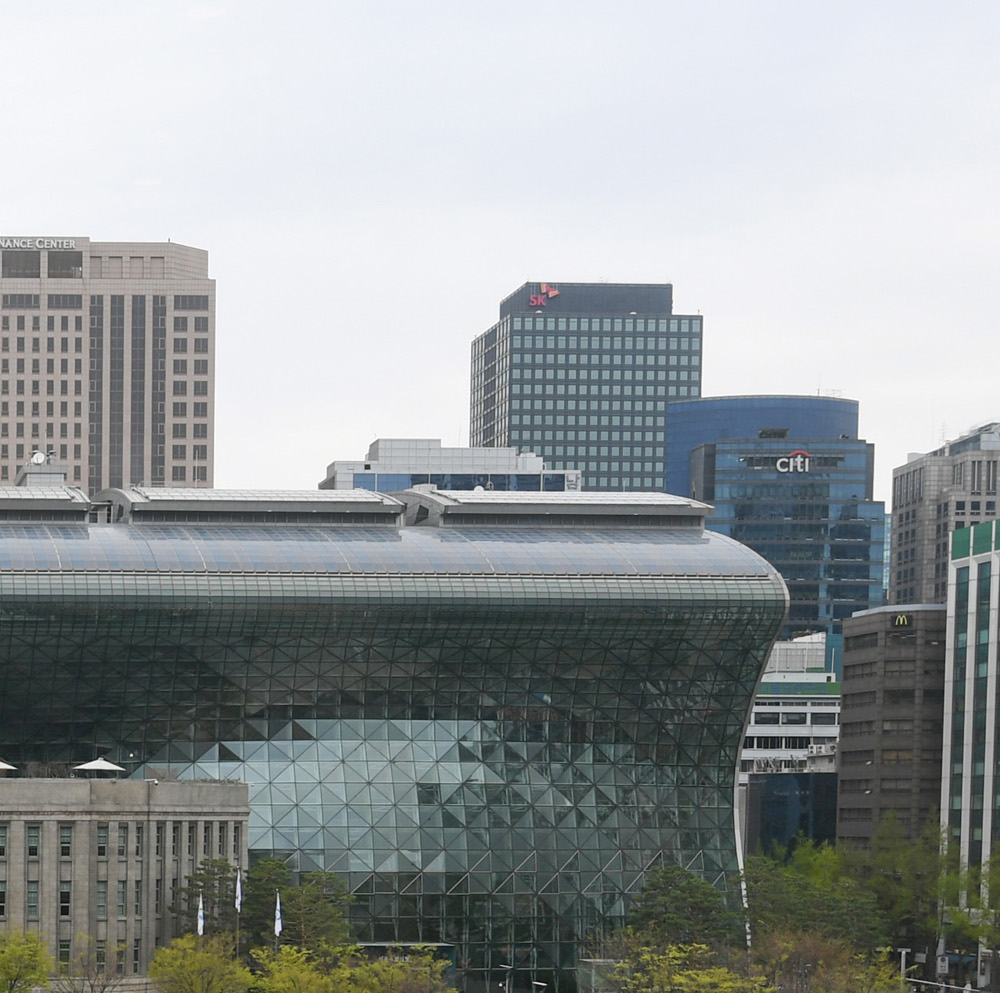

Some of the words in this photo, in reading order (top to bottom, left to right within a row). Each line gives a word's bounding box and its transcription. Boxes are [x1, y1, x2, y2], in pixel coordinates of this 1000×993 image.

[35, 238, 76, 249] CENTER
[530, 294, 546, 306] SK
[776, 454, 809, 472] citi
